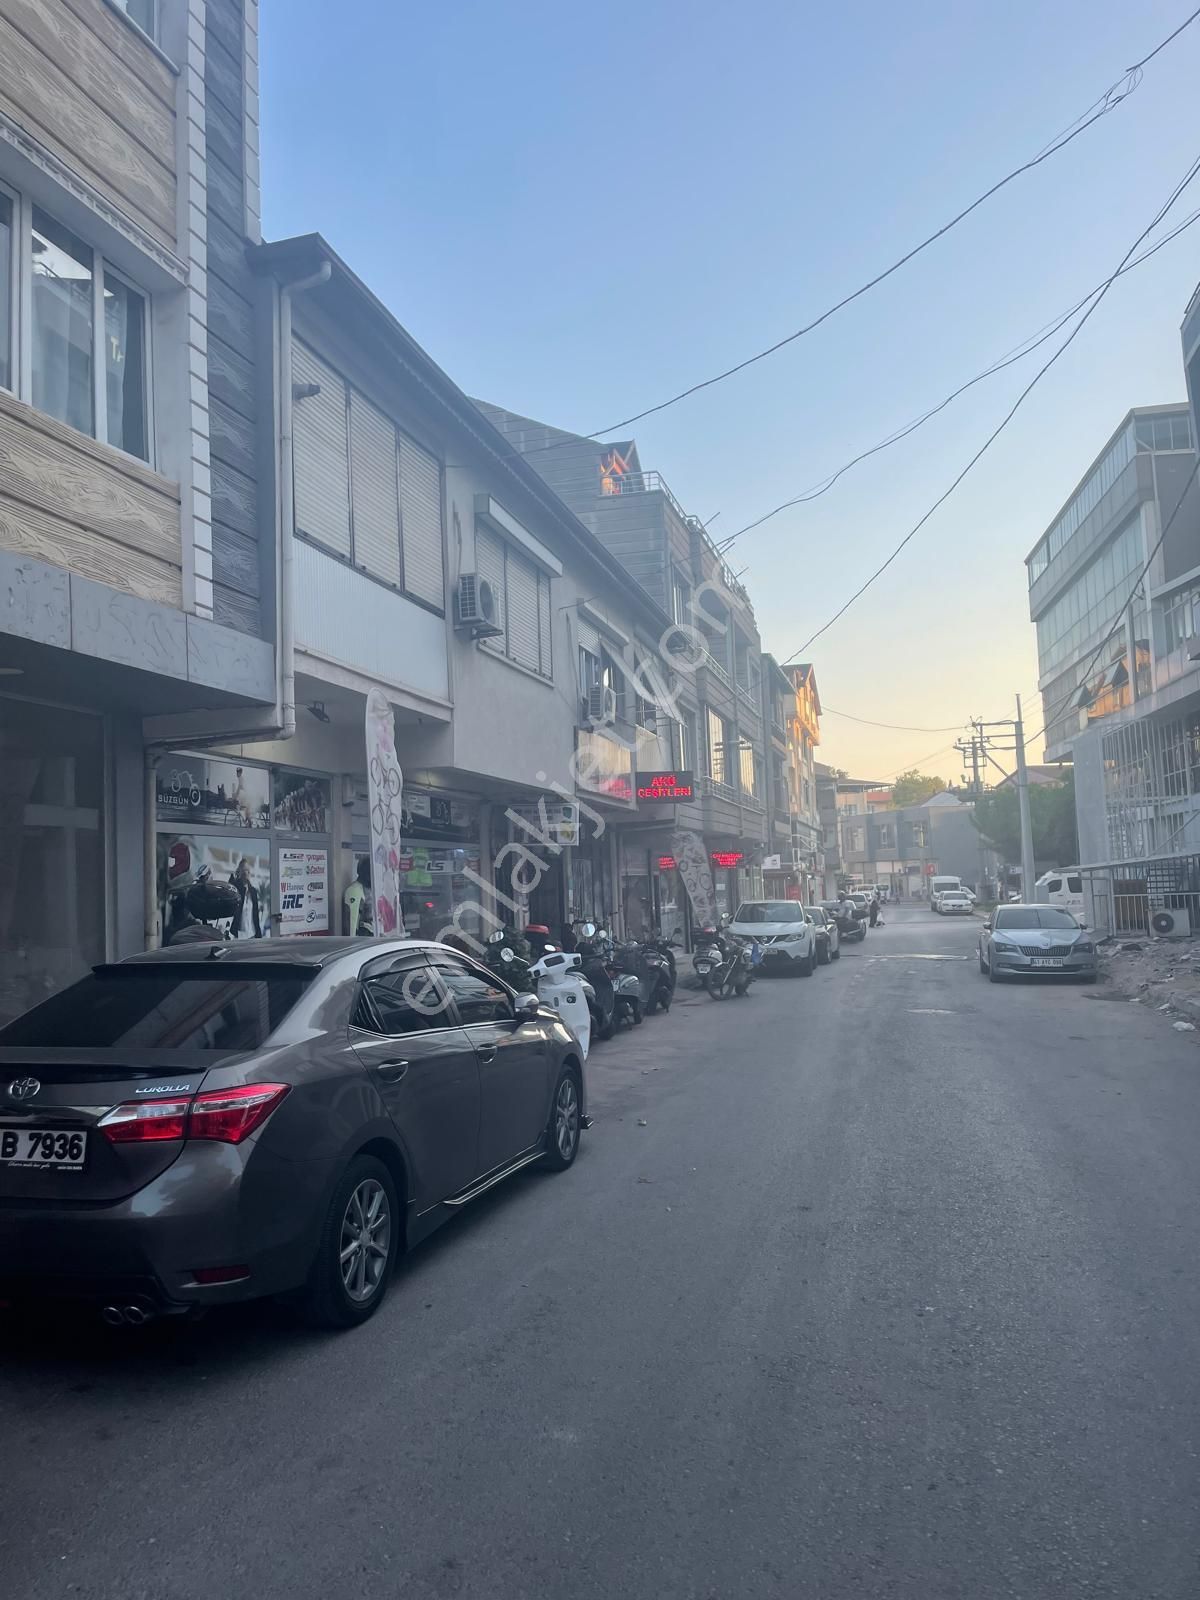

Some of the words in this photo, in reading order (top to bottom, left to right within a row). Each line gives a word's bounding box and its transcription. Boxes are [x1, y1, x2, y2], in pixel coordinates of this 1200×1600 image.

[651, 775, 676, 786] AKÜ
[135, 1084, 190, 1094] COROLLA
[27, 1132, 84, 1160] 7936
